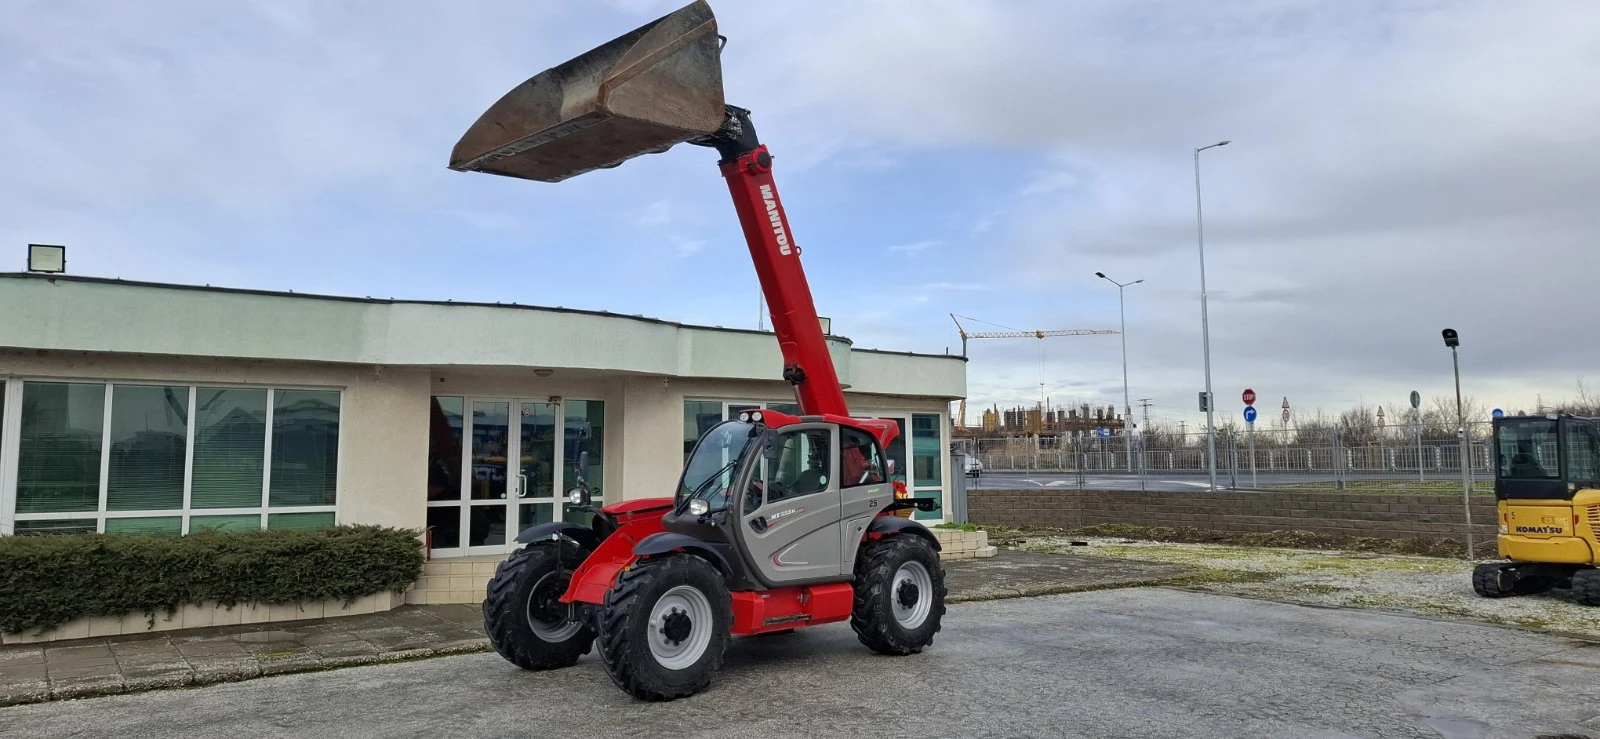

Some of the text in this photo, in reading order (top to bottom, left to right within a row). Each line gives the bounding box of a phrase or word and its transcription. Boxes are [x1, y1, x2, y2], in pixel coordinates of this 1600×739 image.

[760, 184, 792, 256] MANITOU
[1243, 393, 1254, 401] STOP
[869, 499, 878, 508] 25
[1511, 511, 1516, 520] 5
[1516, 525, 1563, 534] KOMATSU
